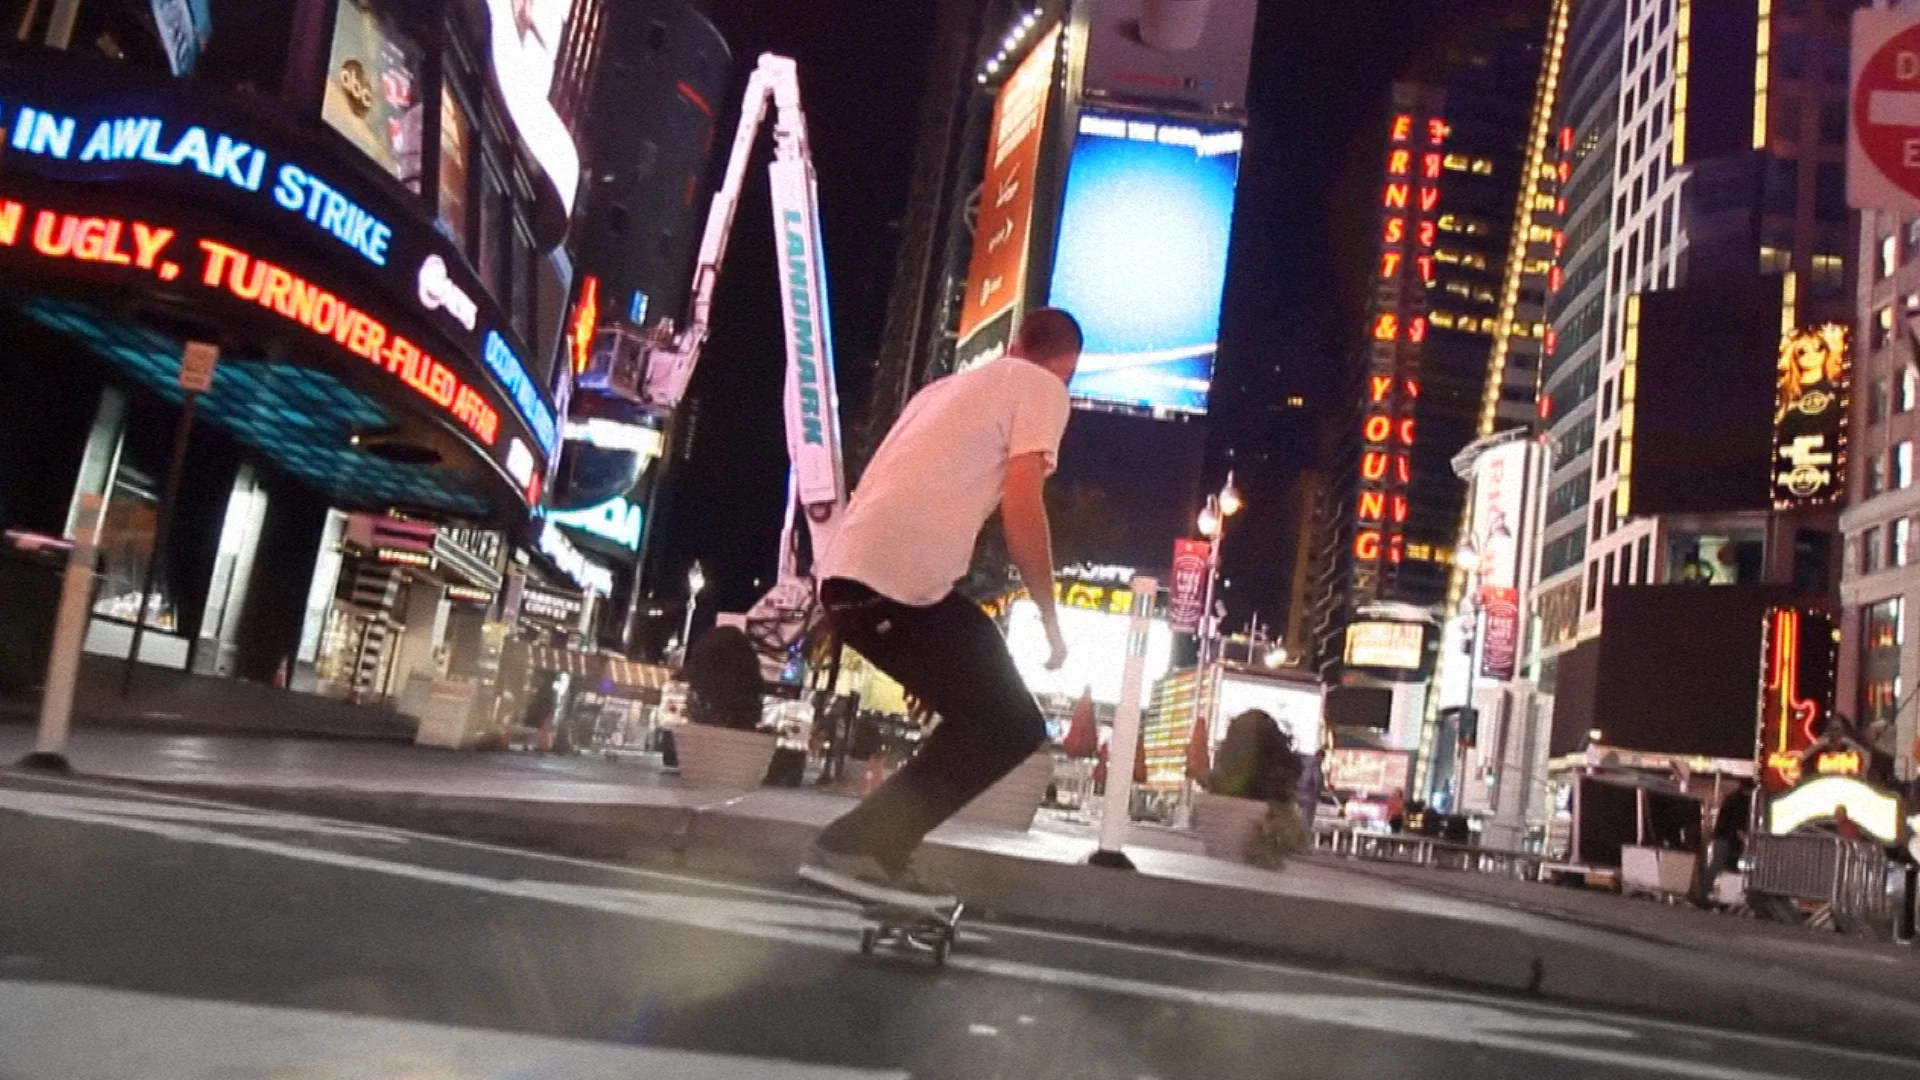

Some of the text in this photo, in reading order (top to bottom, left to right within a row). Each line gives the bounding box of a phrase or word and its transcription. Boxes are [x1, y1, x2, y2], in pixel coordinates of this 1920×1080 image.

[1895, 52, 1919, 80] D
[11, 106, 393, 267] IN AWLAKI STRIKE
[0, 200, 22, 246] N
[33, 209, 181, 281] UGLY,
[198, 239, 456, 408] TURNOVER-FILLED
[783, 208, 823, 446] LANDMARK
[1355, 114, 1412, 560] ERNST & YOUNG
